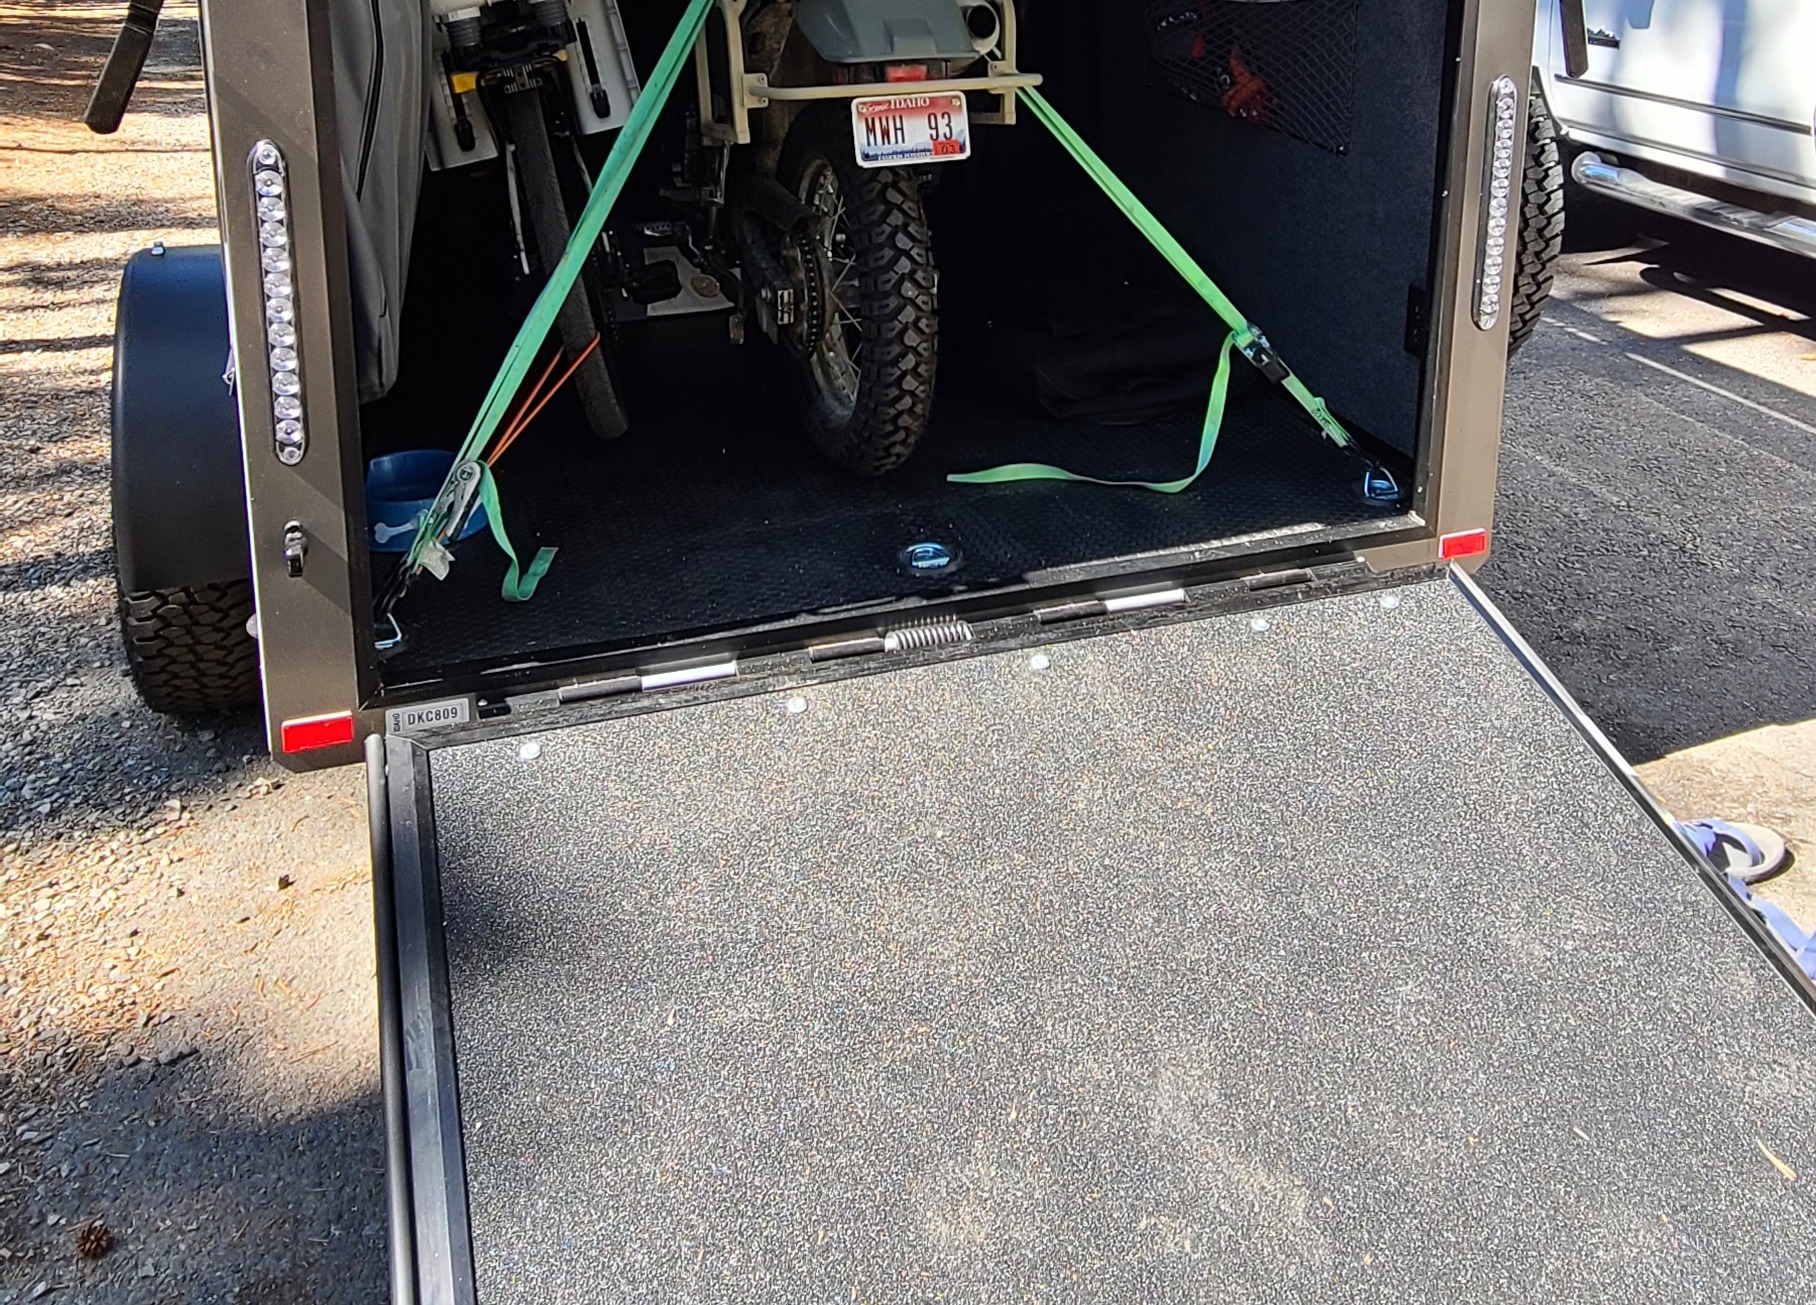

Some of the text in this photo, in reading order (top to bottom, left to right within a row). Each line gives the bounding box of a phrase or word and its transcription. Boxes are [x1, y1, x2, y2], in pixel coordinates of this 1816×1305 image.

[890, 97, 930, 109] IDAHO
[864, 111, 953, 147] MWH 93
[407, 706, 458, 725] DKC809
